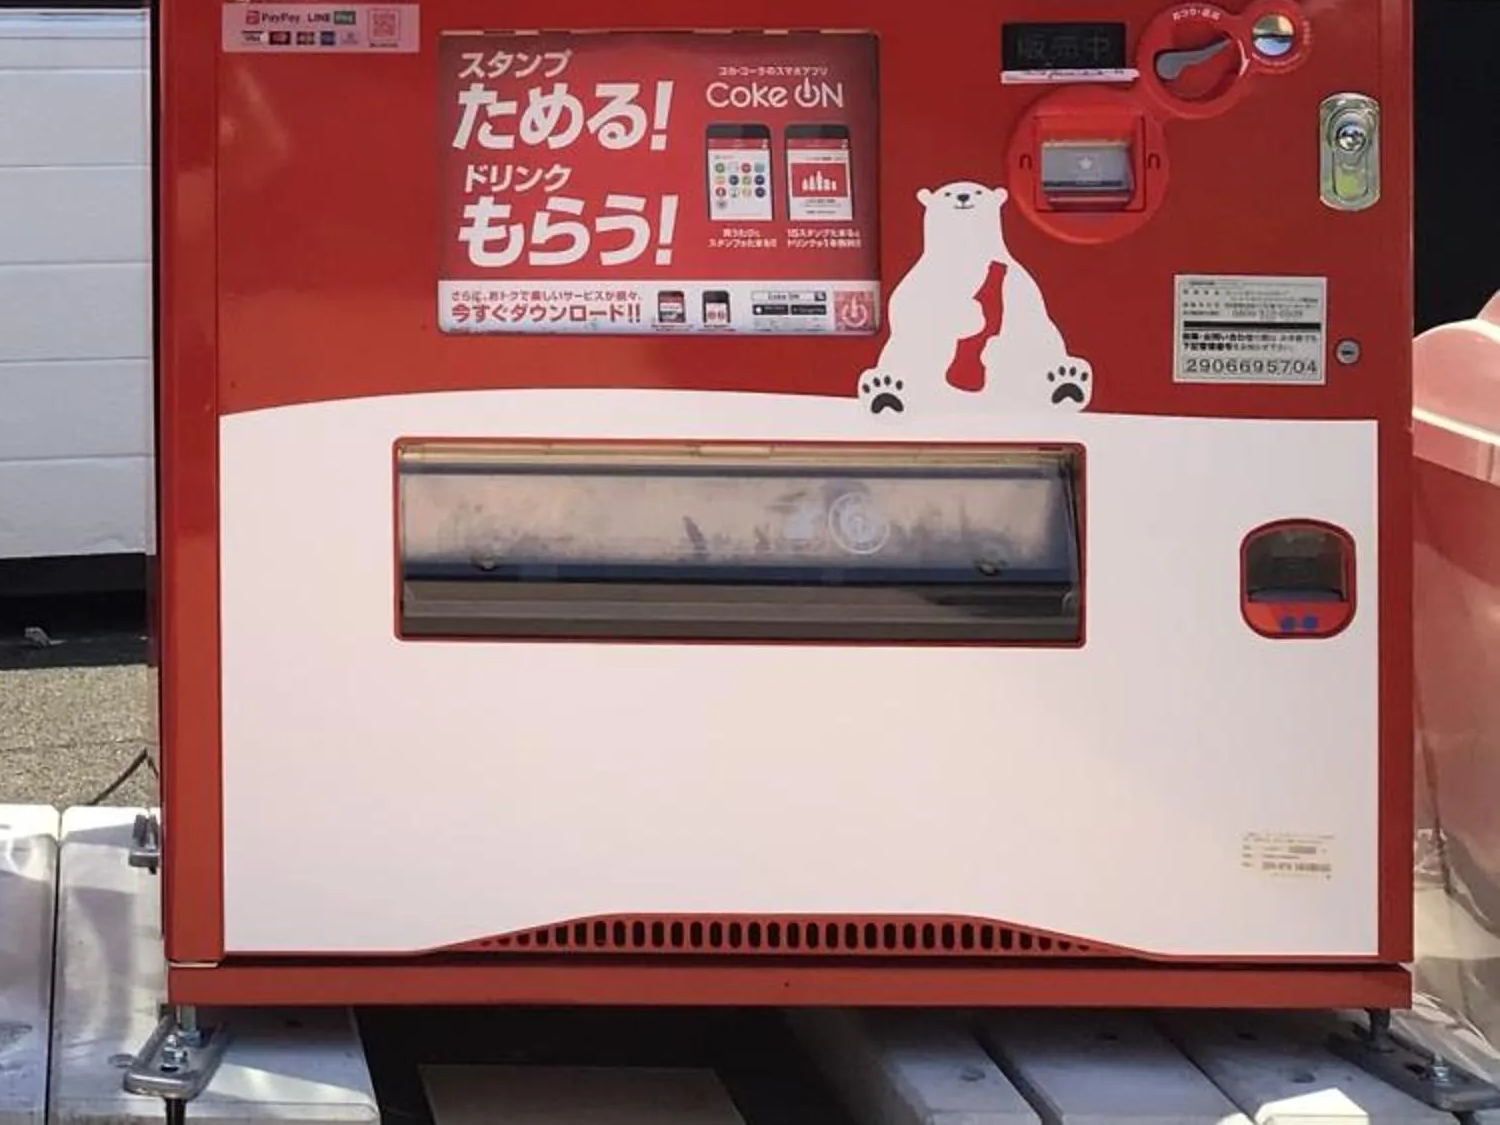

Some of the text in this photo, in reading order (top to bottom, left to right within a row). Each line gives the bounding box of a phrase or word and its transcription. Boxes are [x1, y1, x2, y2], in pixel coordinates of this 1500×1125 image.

[458, 48, 573, 79] スタンプ
[705, 76, 844, 108] Coke ON
[452, 80, 675, 151] ためる!
[464, 163, 572, 194] ドリンク
[457, 193, 679, 268] もらう!
